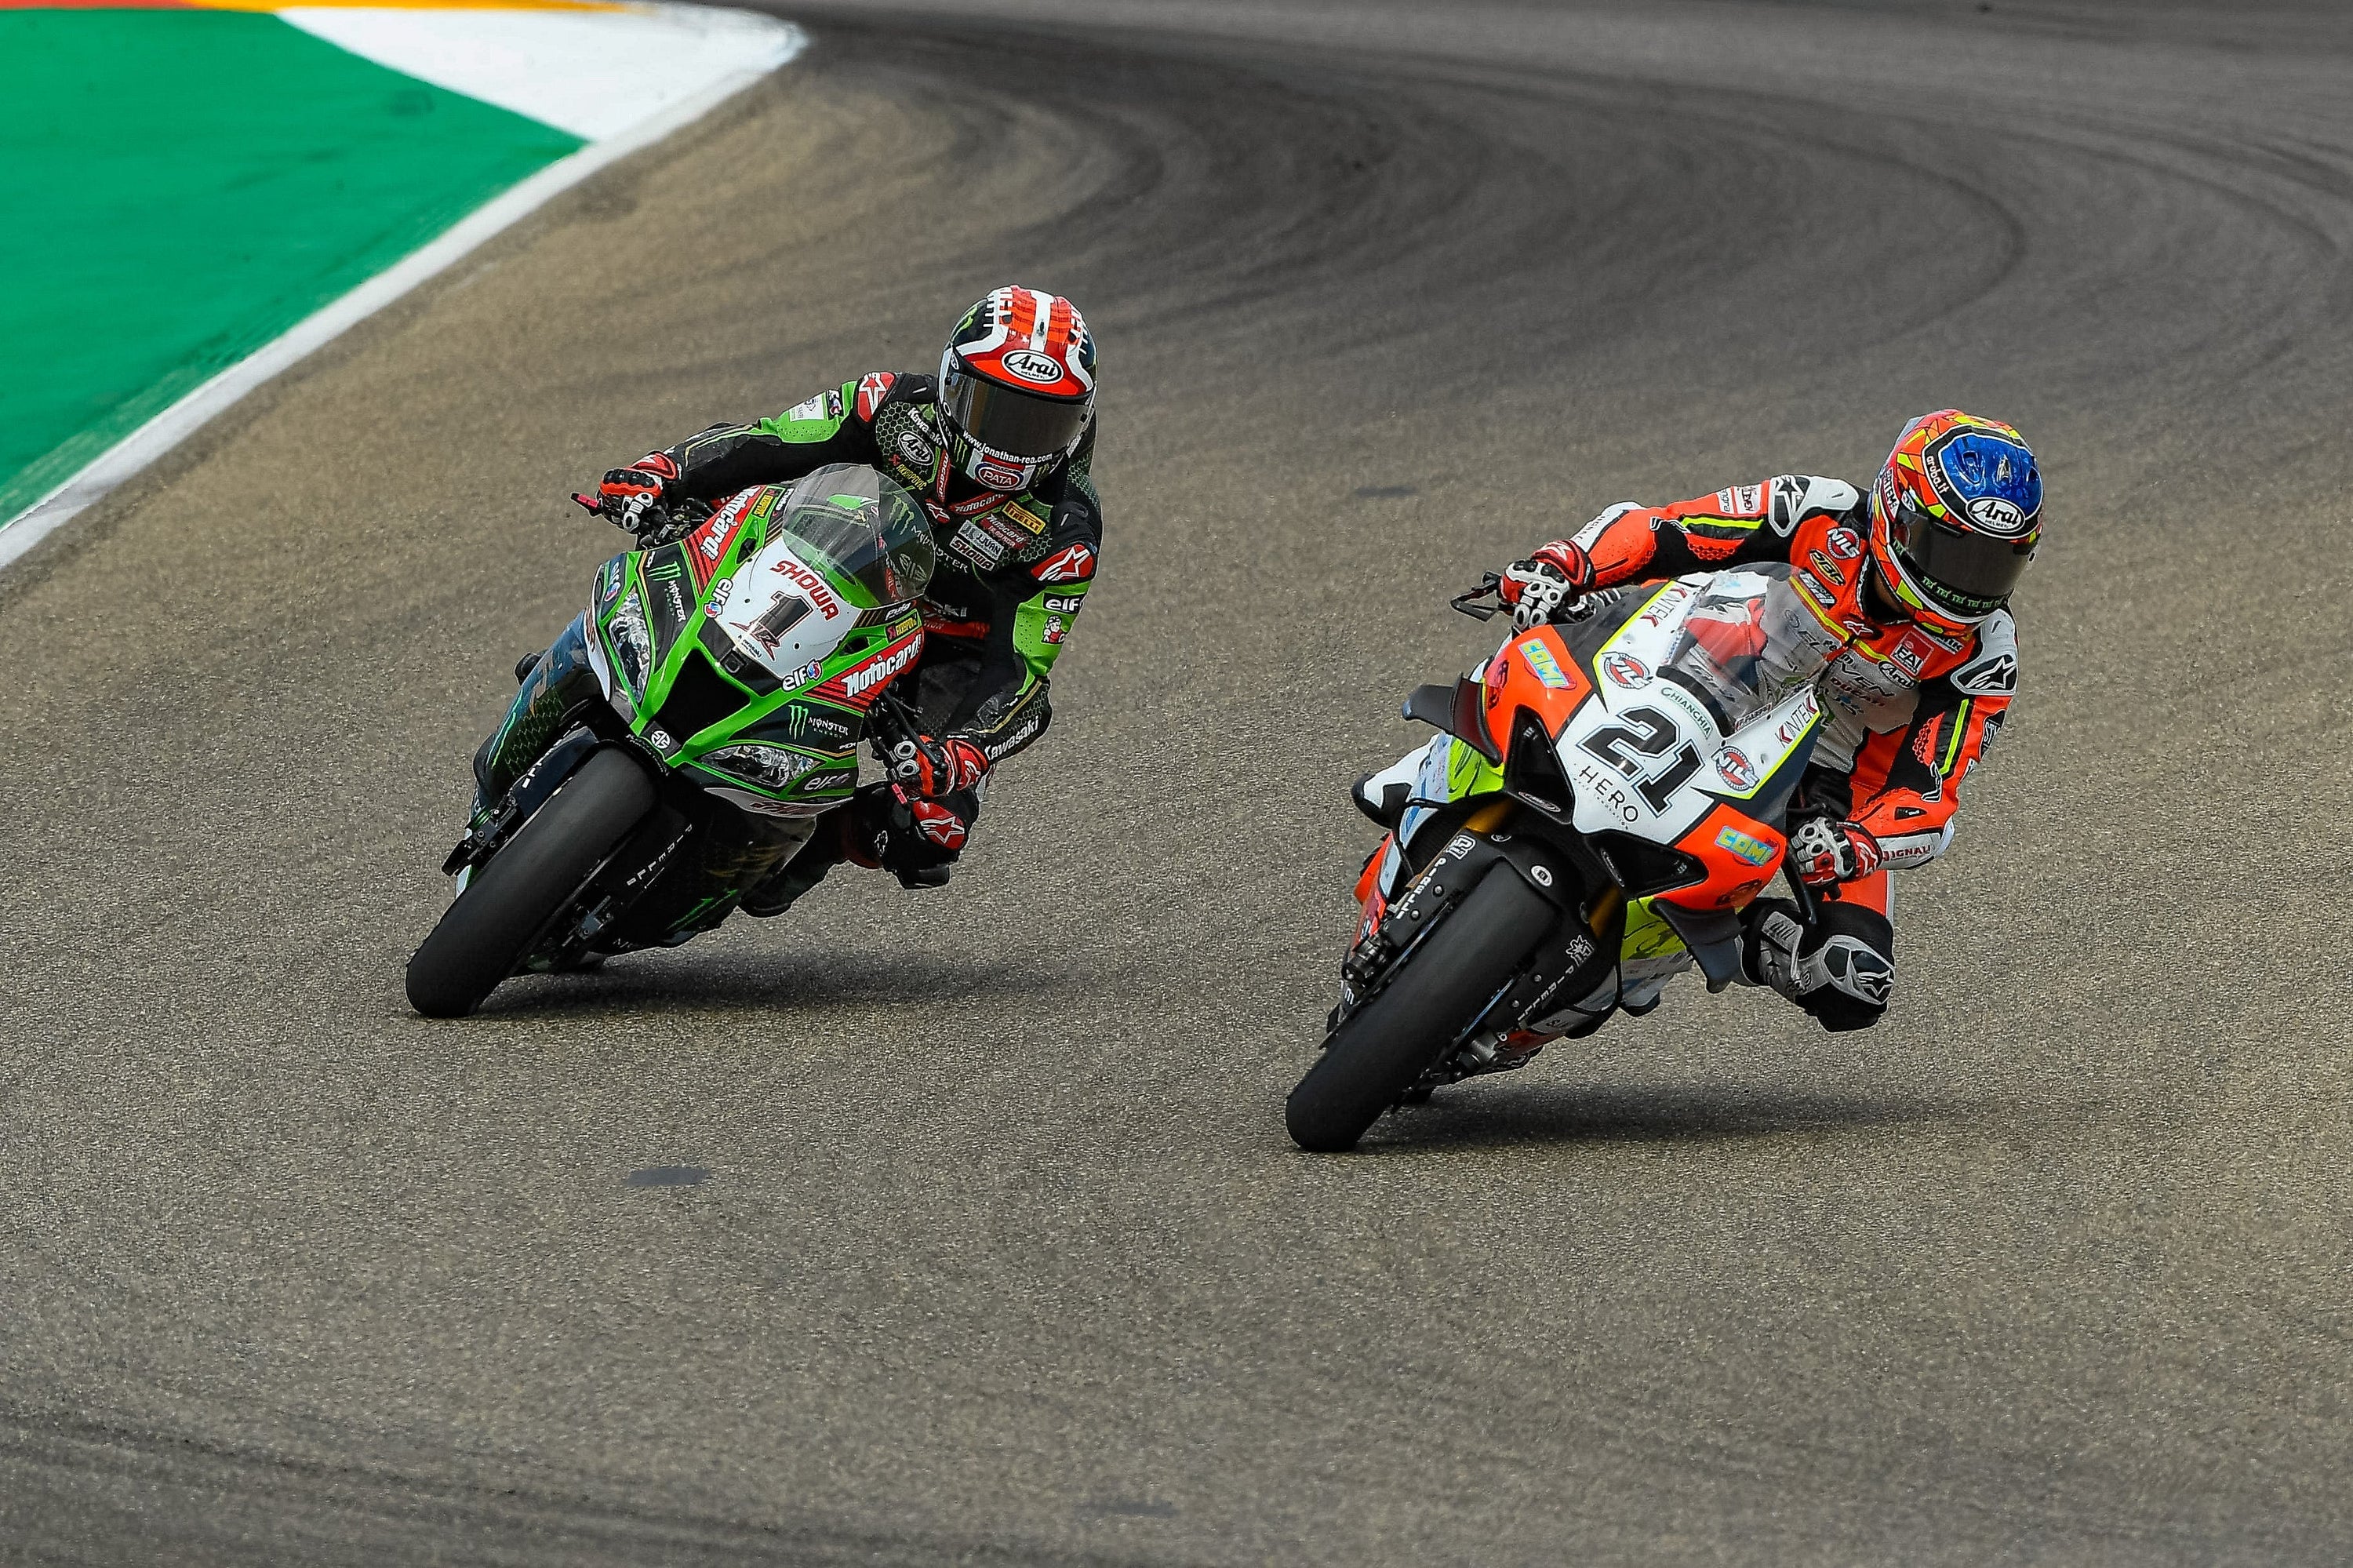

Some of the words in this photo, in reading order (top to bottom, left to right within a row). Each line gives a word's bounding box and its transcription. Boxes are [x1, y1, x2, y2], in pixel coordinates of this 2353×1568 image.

[1008, 355, 1056, 377] Arai
[907, 407, 942, 446] Kawaaki
[963, 430, 1053, 463] www.jonathan-rea.com
[984, 471, 1012, 485] PATA
[955, 493, 1004, 511] Motocar
[1970, 501, 2020, 526] Arai
[954, 540, 994, 569] SHOWA
[1827, 528, 1860, 558] NILS
[667, 579, 686, 622] MONSTER
[712, 578, 733, 606] elf
[769, 559, 840, 621] SHOWA
[1046, 598, 1080, 612] elf
[783, 667, 809, 691] elf
[842, 634, 922, 699] Motocard
[1601, 651, 1653, 689] NILS
[808, 716, 849, 736] MONSTER
[1660, 686, 1713, 735] CHIANCHIA
[1775, 695, 1819, 749] KINTEK
[1577, 705, 1706, 819] 21
[1711, 748, 1759, 789] NILS
[805, 774, 833, 791] elf
[1579, 765, 1639, 823] HERO
[1396, 857, 1446, 920] PIRELLI
